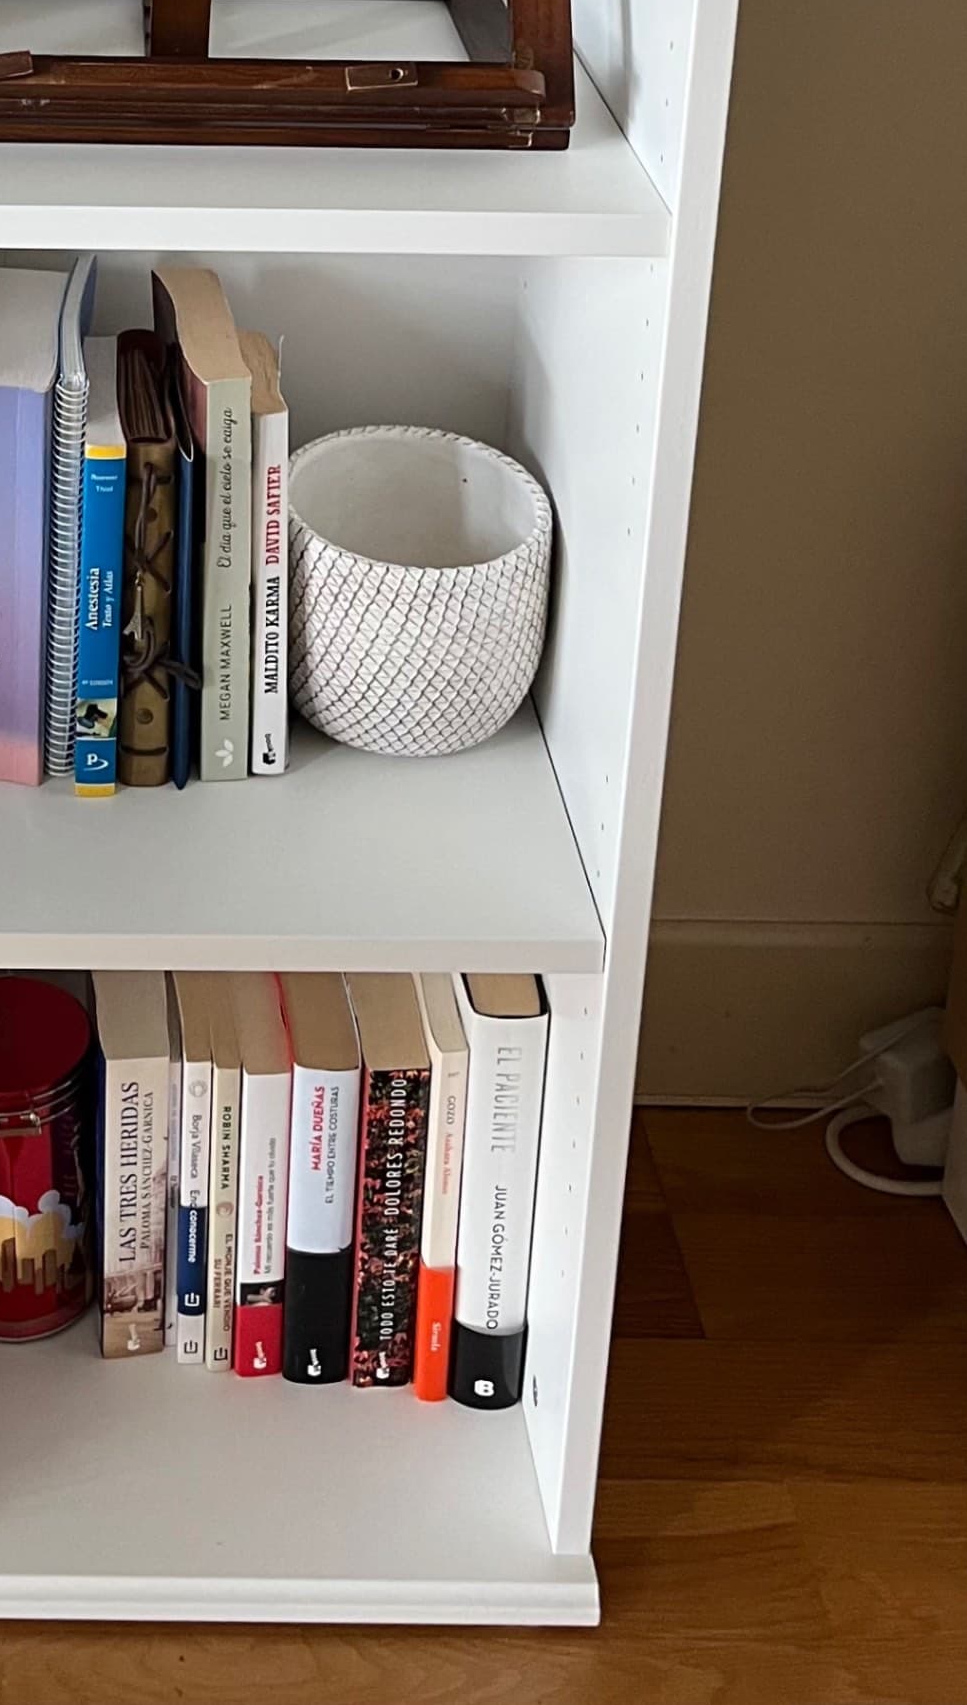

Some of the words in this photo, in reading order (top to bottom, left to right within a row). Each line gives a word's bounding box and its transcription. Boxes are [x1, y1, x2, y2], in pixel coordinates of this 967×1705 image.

[222, 407, 237, 444] caiga
[222, 446, 232, 460] se
[219, 463, 232, 492] cielo
[266, 465, 281, 515] SAFIER
[219, 494, 232, 506] el
[222, 508, 237, 531] que
[265, 519, 281, 566] DAVID
[216, 557, 232, 568] El
[85, 568, 100, 630] Anestesia
[265, 575, 280, 627] KARMA
[219, 605, 232, 669] MAXWELL
[264, 631, 280, 694] MALDITO
[219, 673, 231, 721] MEGAN
[497, 1046, 523, 1065] EL
[120, 1081, 140, 1167] HERIDAS
[189, 1114, 203, 1139] Borja
[221, 1106, 232, 1140] ROBIN
[311, 1086, 325, 1132] DUEÑAS
[328, 1086, 339, 1131] COSTURAS
[387, 1079, 407, 1146] REDONDO
[446, 1095, 456, 1125] GOZO
[491, 1072, 521, 1153] PACIENTE
[140, 1092, 154, 1203] SÁNCHEZ-GARNICA
[190, 1142, 202, 1179] Vilaseca
[309, 1135, 322, 1171] MARÍA
[327, 1133, 336, 1159] ENTRE
[220, 1145, 231, 1190] SHARMA
[325, 1160, 336, 1192] TIEMPO
[384, 1152, 403, 1215] DOLORES
[119, 1173, 138, 1222] TRES
[325, 1194, 334, 1204] EL
[494, 1184, 507, 1220] JUAN
[118, 1226, 138, 1262] LAS
[139, 1205, 152, 1249] PALOMA
[187, 1210, 198, 1263] conocerme
[225, 1234, 233, 1244] EL
[383, 1228, 399, 1257] DARÉ
[223, 1278, 232, 1295] QUE
[383, 1262, 396, 1275] TE
[486, 1224, 508, 1330] GÓMEZ-JURADO
[381, 1279, 396, 1306] ESTO
[379, 1312, 394, 1340] TODO
